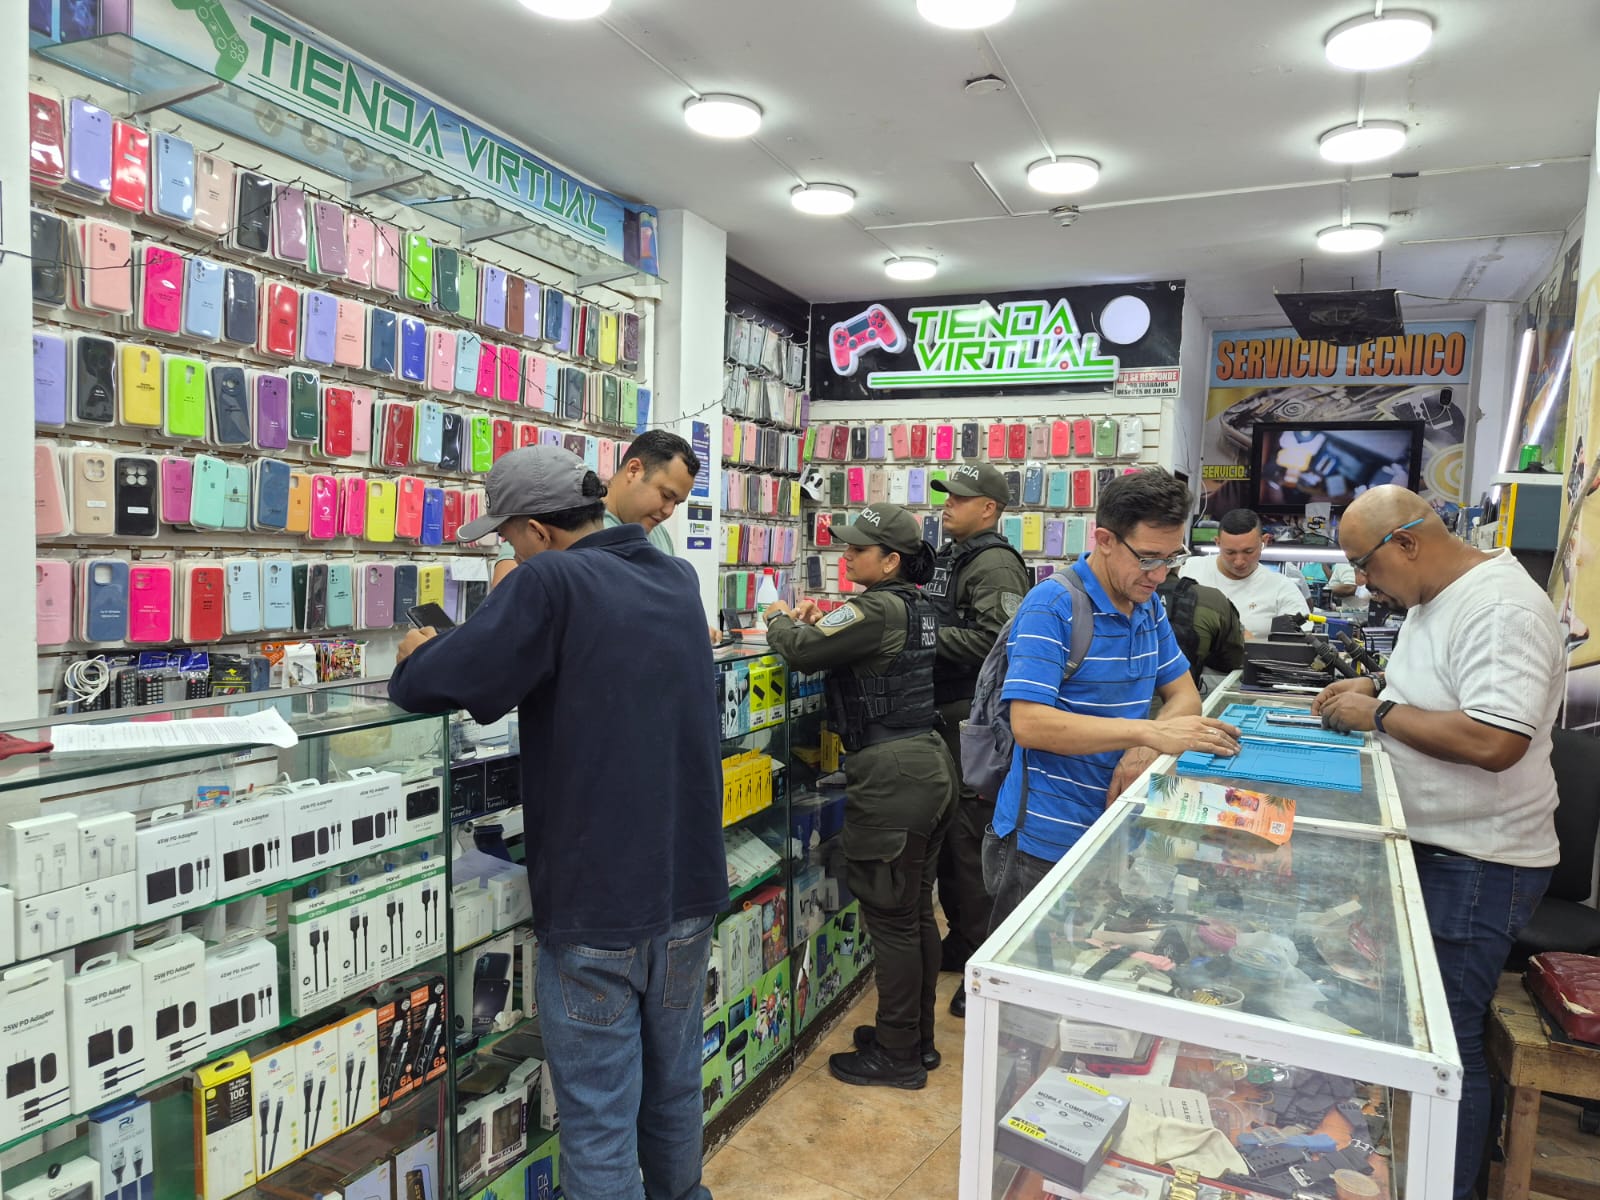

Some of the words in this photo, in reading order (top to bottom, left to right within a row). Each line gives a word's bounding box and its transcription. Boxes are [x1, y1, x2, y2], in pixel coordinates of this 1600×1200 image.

[250, 16, 444, 159] TIENDA
[460, 125, 606, 236] VIRTUAL
[912, 304, 1073, 341] TIENDA
[918, 337, 1114, 371] VIRTUAL
[1216, 337, 1338, 380] SERVICIO
[1140, 371, 1177, 381] RESPONDE
[1202, 465, 1245, 478] SERVICIO
[154, 973, 166, 981] 25W
[166, 969, 175, 977] PD
[175, 962, 195, 974] Adapter
[84, 994, 98, 1004] 25W
[99, 991, 108, 1000] PD
[108, 984, 132, 996] Adapter
[3, 1022, 19, 1033] 25W
[19, 1018, 30, 1028] PD
[30, 1009, 55, 1023] Adapter
[1037, 1091, 1062, 1104] MOBILE
[1064, 1101, 1105, 1123] COMPANION
